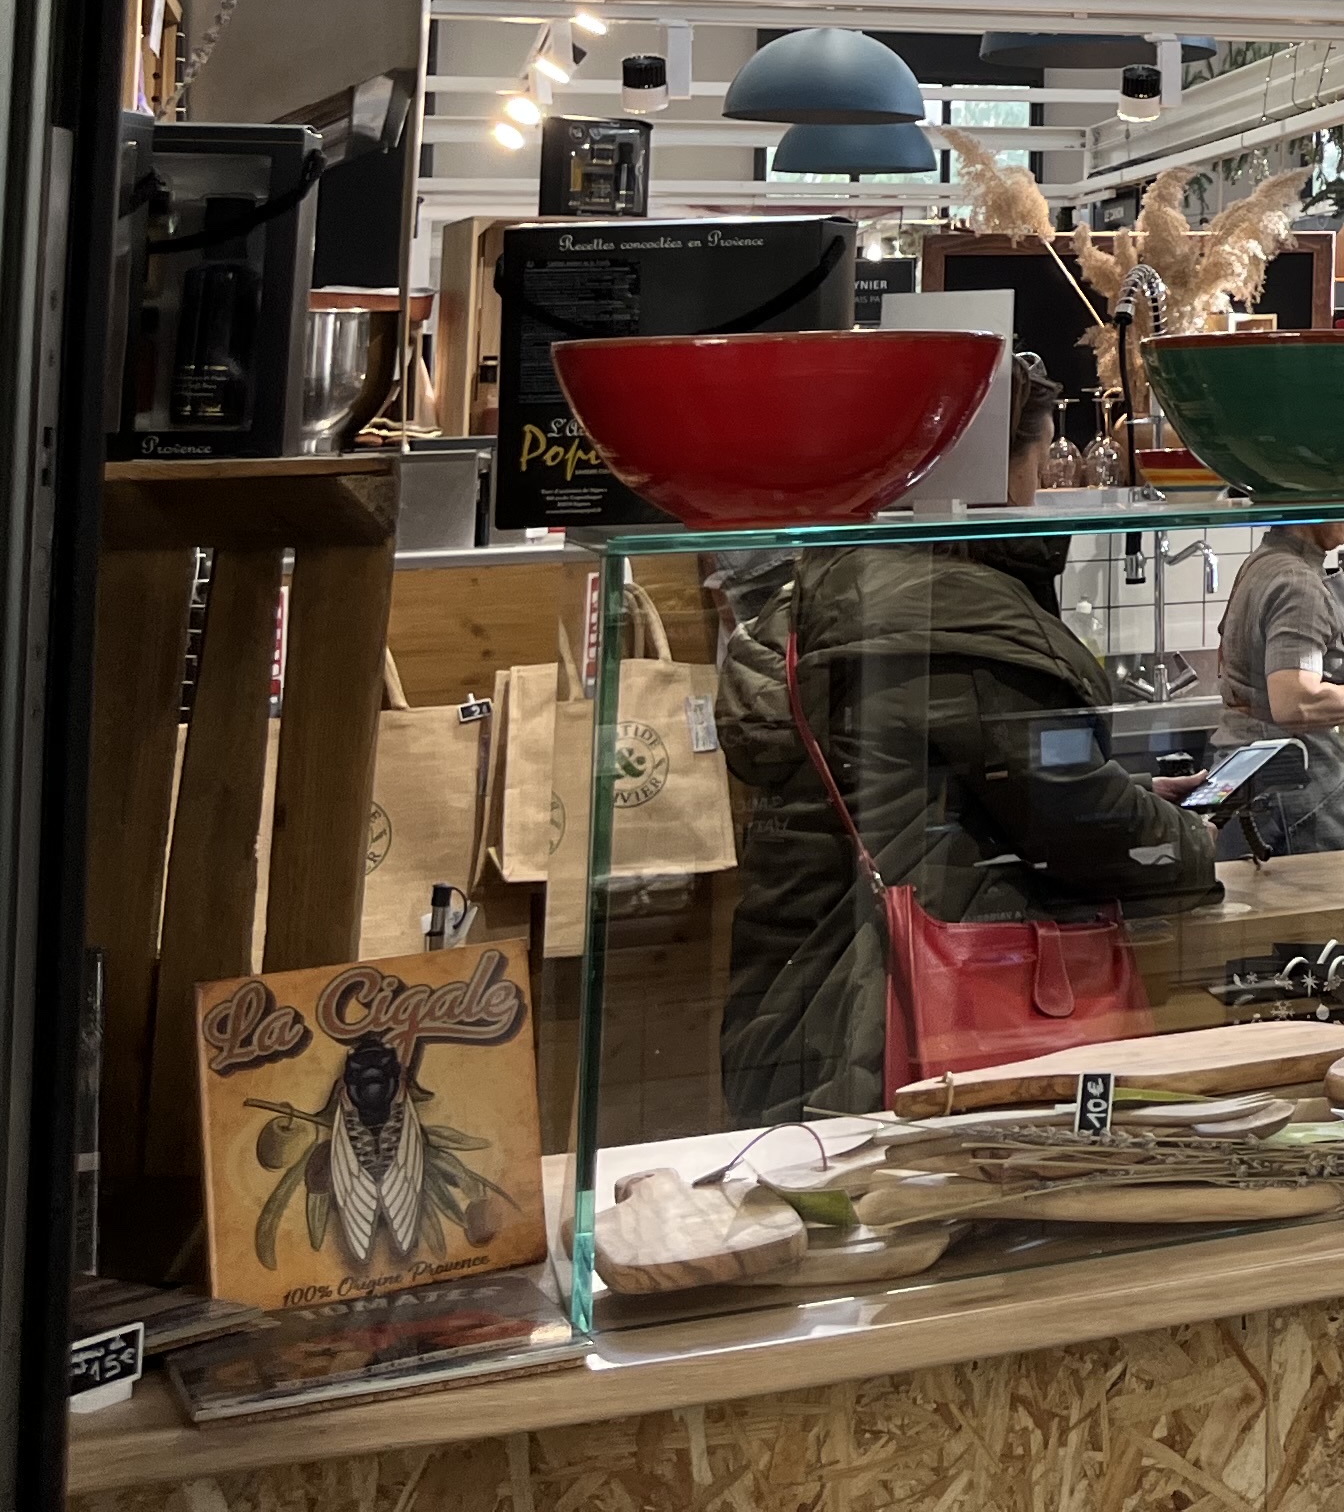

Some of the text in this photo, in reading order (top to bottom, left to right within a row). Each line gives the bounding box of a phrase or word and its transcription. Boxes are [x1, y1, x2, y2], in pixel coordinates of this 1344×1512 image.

[559, 230, 764, 251] Recettes concoctées en Provence
[141, 436, 212, 455] Provence
[203, 949, 532, 1078] La Cigale
[1086, 1076, 1108, 1129] 10€
[283, 1278, 333, 1306] 100%
[408, 1253, 491, 1283] Provence
